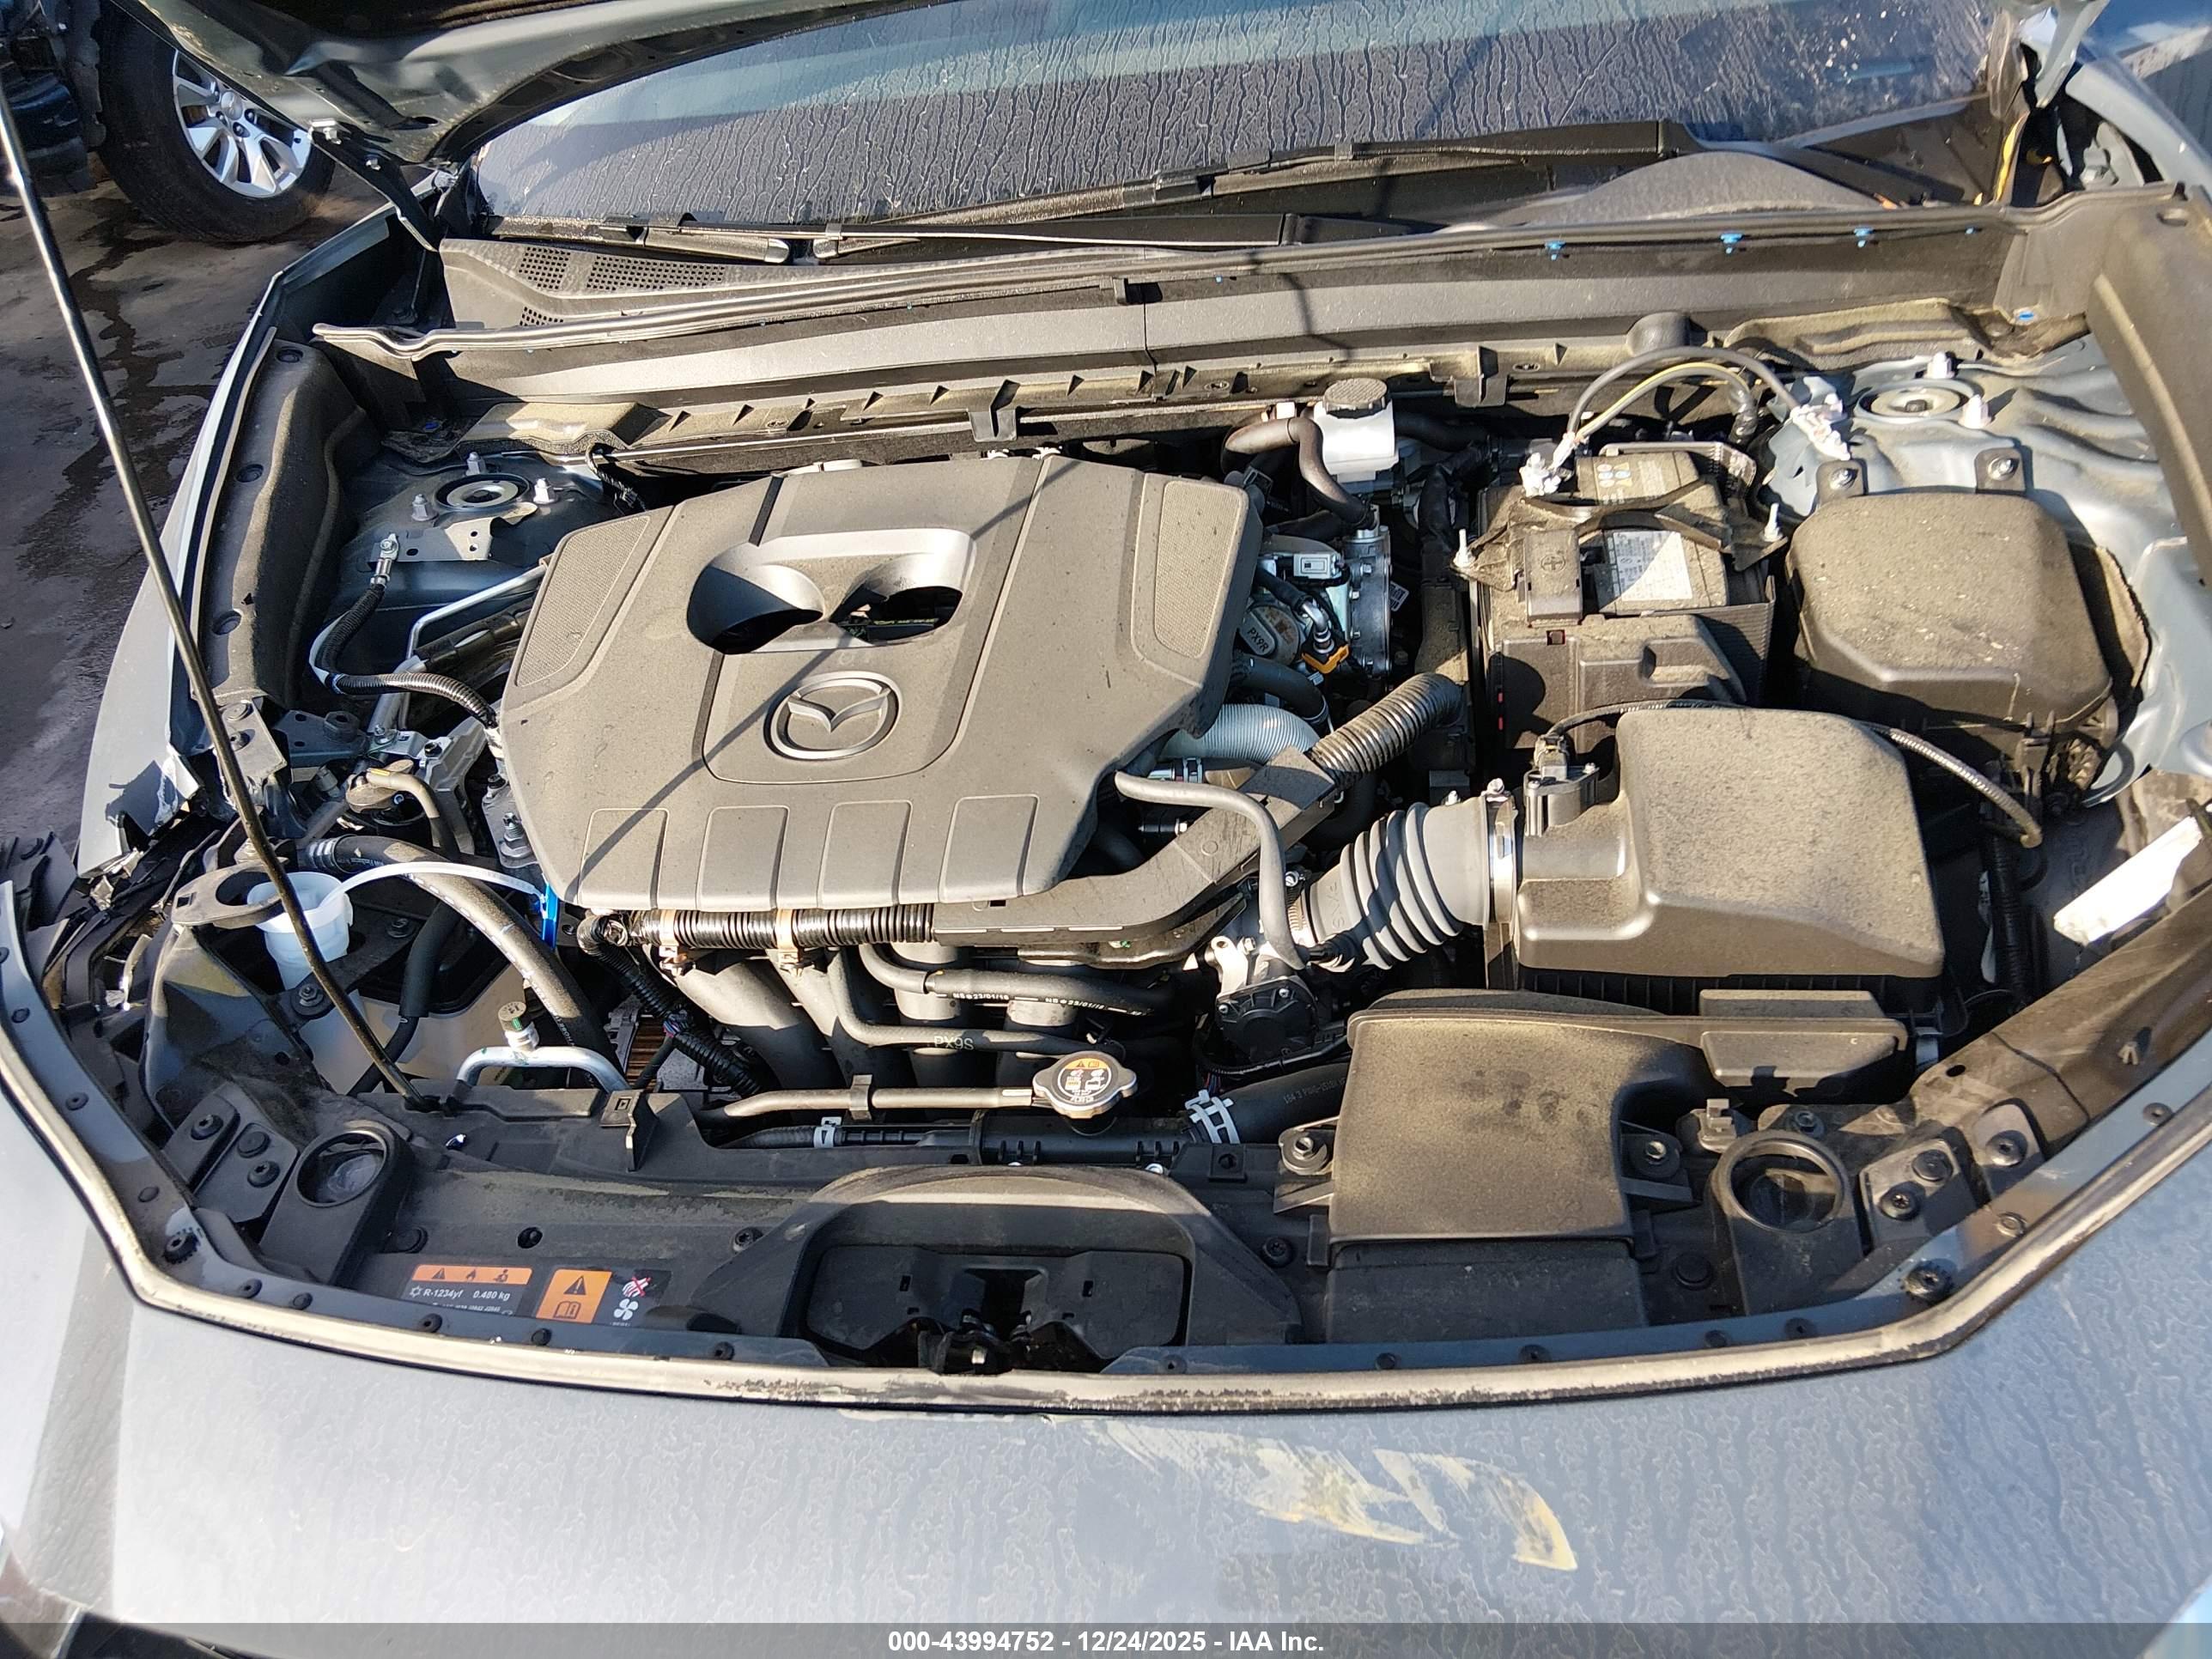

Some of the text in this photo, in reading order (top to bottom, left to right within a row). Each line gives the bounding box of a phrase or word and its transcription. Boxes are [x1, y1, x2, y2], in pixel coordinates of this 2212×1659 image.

[1247, 627, 1269, 653] PX9R
[933, 1036, 975, 1051] PX9S
[422, 1288, 464, 1300] R-1234yf
[498, 1291, 511, 1302] kg
